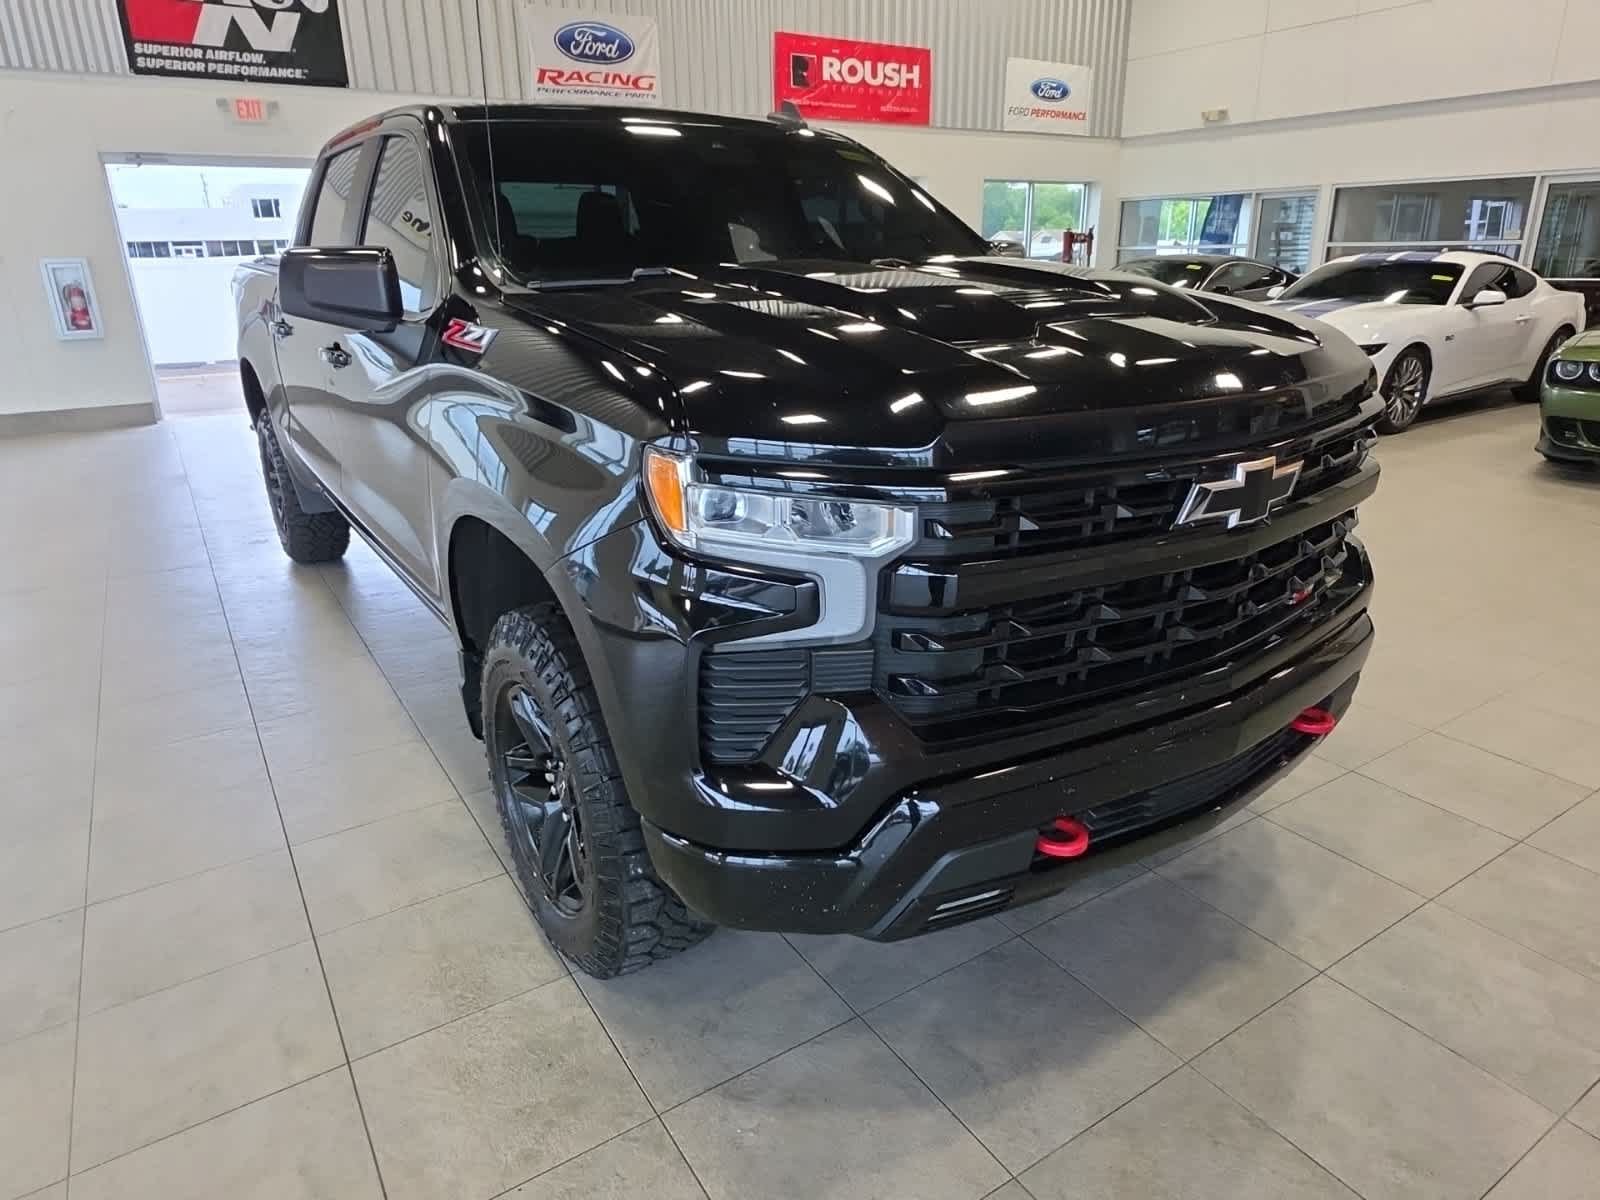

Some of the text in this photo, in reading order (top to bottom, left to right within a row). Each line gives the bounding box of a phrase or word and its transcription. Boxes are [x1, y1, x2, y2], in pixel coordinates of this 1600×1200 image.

[134, 43, 267, 65] SUPERIOR AIRFLOW.
[570, 27, 620, 59] Ford
[136, 57, 206, 73] SUPERIOR
[822, 55, 921, 89] ROUSH
[537, 67, 656, 91] RACING
[1037, 81, 1063, 98] Ford
[537, 87, 657, 100] PERFORMANCE PARTS
[235, 98, 262, 120] EXIT
[1008, 106, 1087, 121] FORD PERFORMANCE
[441, 317, 500, 354] Z71
